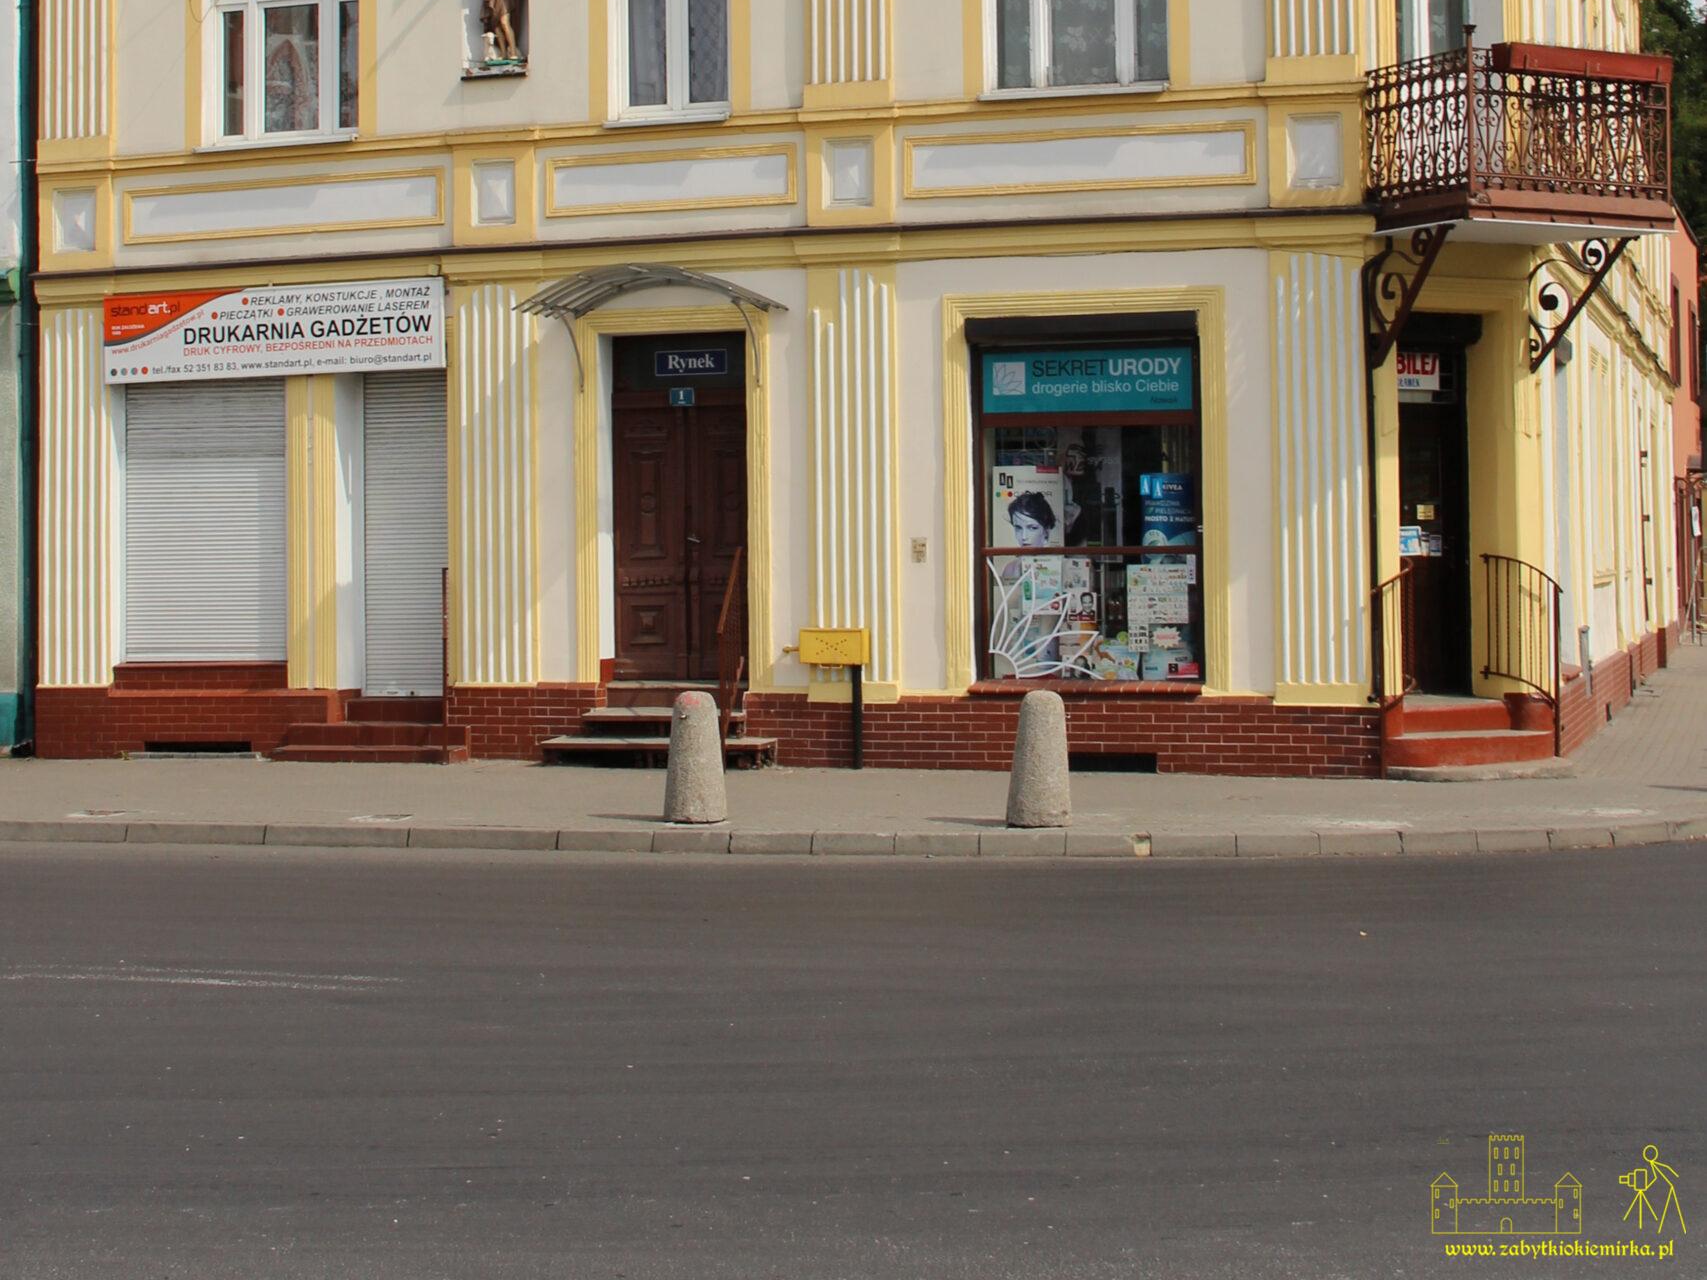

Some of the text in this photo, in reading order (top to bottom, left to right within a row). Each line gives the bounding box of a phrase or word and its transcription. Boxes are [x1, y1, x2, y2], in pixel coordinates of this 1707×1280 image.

[286, 300, 430, 317] GRAWEROWANIE LASEREM
[184, 312, 432, 345] DRUKARNIA GADŻETÓW
[183, 347, 210, 357] DRUK
[213, 344, 263, 355] CYFROWY,
[338, 339, 351, 348] NA
[354, 335, 433, 348] PRZEDMIOTACH
[183, 364, 193, 373] 52
[196, 363, 211, 372] 351
[213, 362, 223, 372] 83
[349, 353, 432, 365] biuro@standart.pl
[668, 354, 715, 373] Rynek
[679, 390, 684, 400] 1
[1032, 379, 1179, 396] drogerie blisko Ciebie
